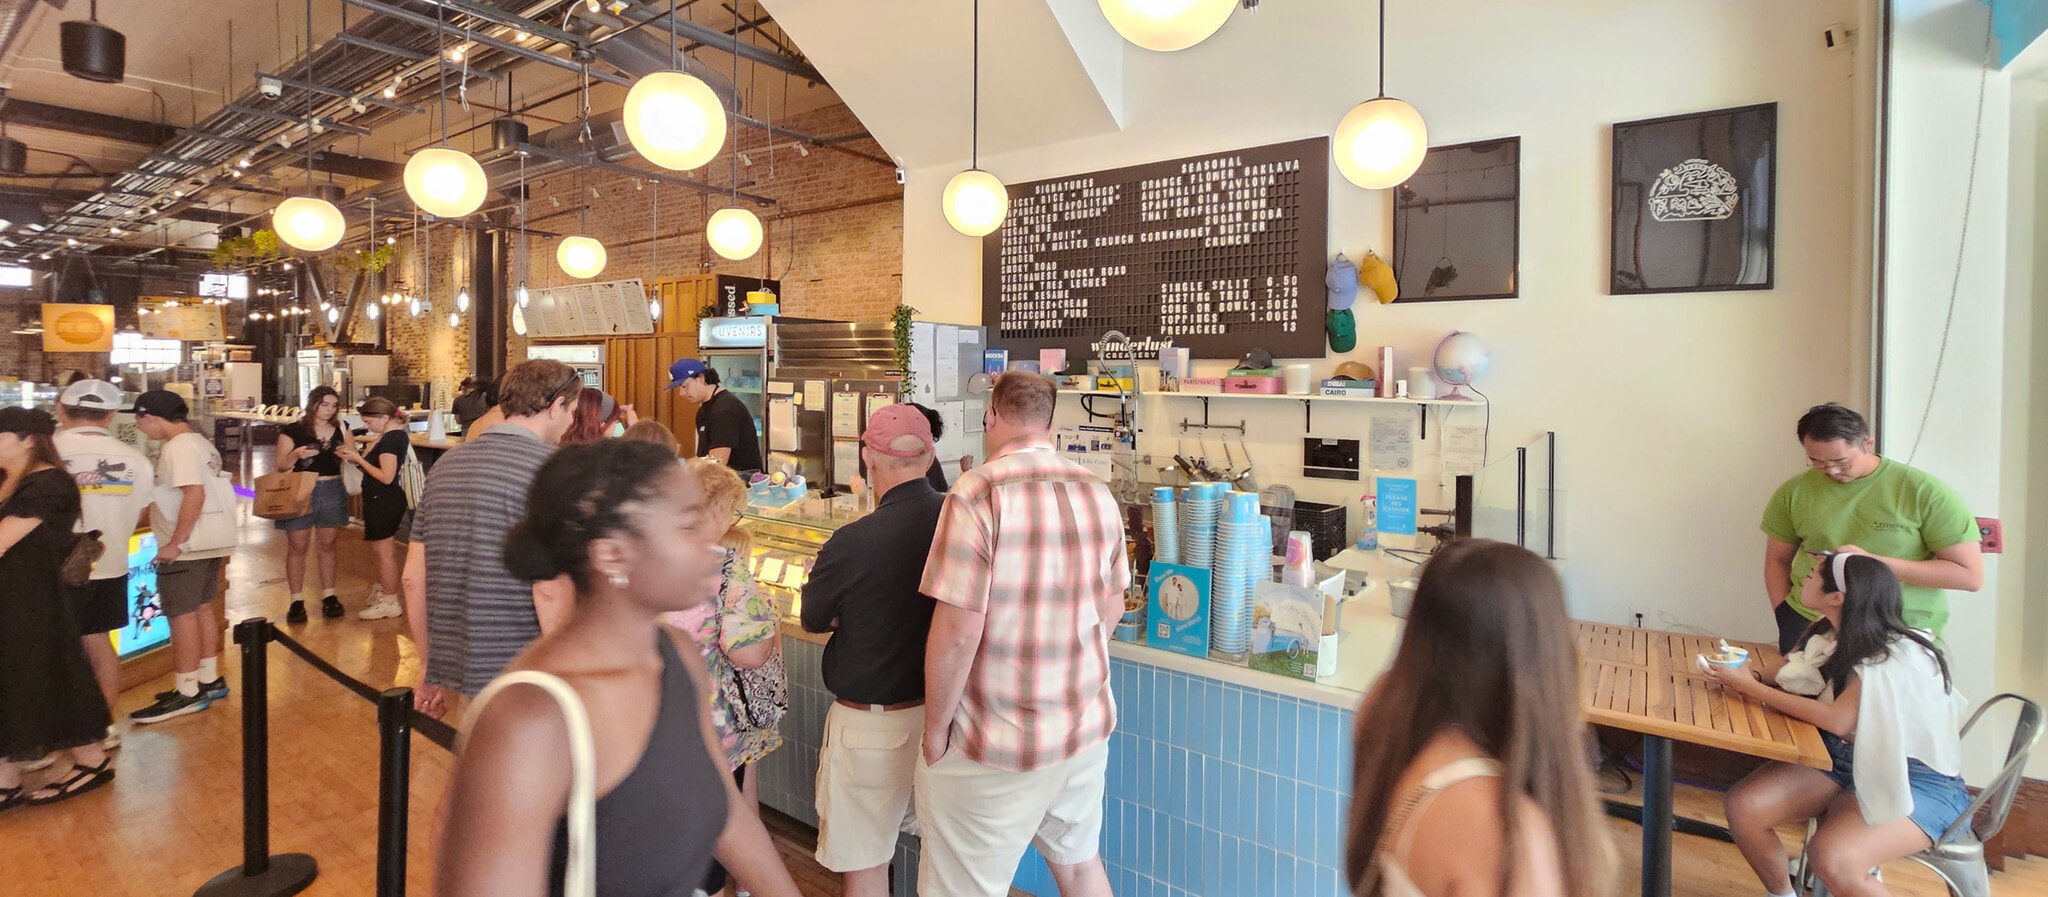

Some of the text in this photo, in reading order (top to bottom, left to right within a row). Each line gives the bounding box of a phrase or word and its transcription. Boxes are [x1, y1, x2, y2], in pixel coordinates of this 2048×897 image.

[1181, 156, 1241, 174] SEASONAL
[1141, 159, 1300, 190] ORANGE FLOWER BAKLAVA
[1035, 178, 1094, 194] SIGNATURES
[1141, 174, 1274, 200] AUSTRALIAN PAVLOVA
[1008, 197, 1034, 208] TICKY
[1041, 192, 1064, 204] RICE
[1008, 196, 1114, 218] APANESE NEAPOLITAN
[1141, 187, 1266, 212] SPANISH GIN TONIC
[1024, 213, 1058, 226] MALTED
[1064, 208, 1100, 220] CRUNCH
[1141, 210, 1167, 222] THAI
[1205, 208, 1282, 226] SUGAR BOBA
[1002, 224, 1051, 237] VEGAN UBE
[1220, 221, 1266, 234] BUTTER
[1002, 230, 1075, 246] PASSION FRUIT
[1002, 234, 1134, 256] ABUELITA MALTED CRUNCH
[1205, 234, 1250, 247] CRUNCH
[1001, 254, 1034, 266] KINDER
[1001, 262, 1056, 274] SMOKY ROAD
[1001, 266, 1126, 284] VIETNAMESE ROCKY ROAD
[1001, 277, 1106, 292] PANDAN TRES LECHES
[1161, 276, 1298, 292] SINGLE SPLIT 6.50
[1001, 290, 1070, 302] BLACK SESAME
[1161, 288, 1298, 303] TASTING TRIO 7.75
[1001, 308, 1088, 320] PISTACCHIO PURO
[1161, 304, 1188, 314] CONE
[1197, 303, 1210, 312] OR
[1220, 301, 1248, 312] BOWL
[1001, 320, 1062, 330] HOKEY POKEY
[1161, 313, 1218, 324] TOPPINGS
[708, 325, 762, 337] OUVENIRS
[1160, 322, 1296, 335] PREPACKED 13
